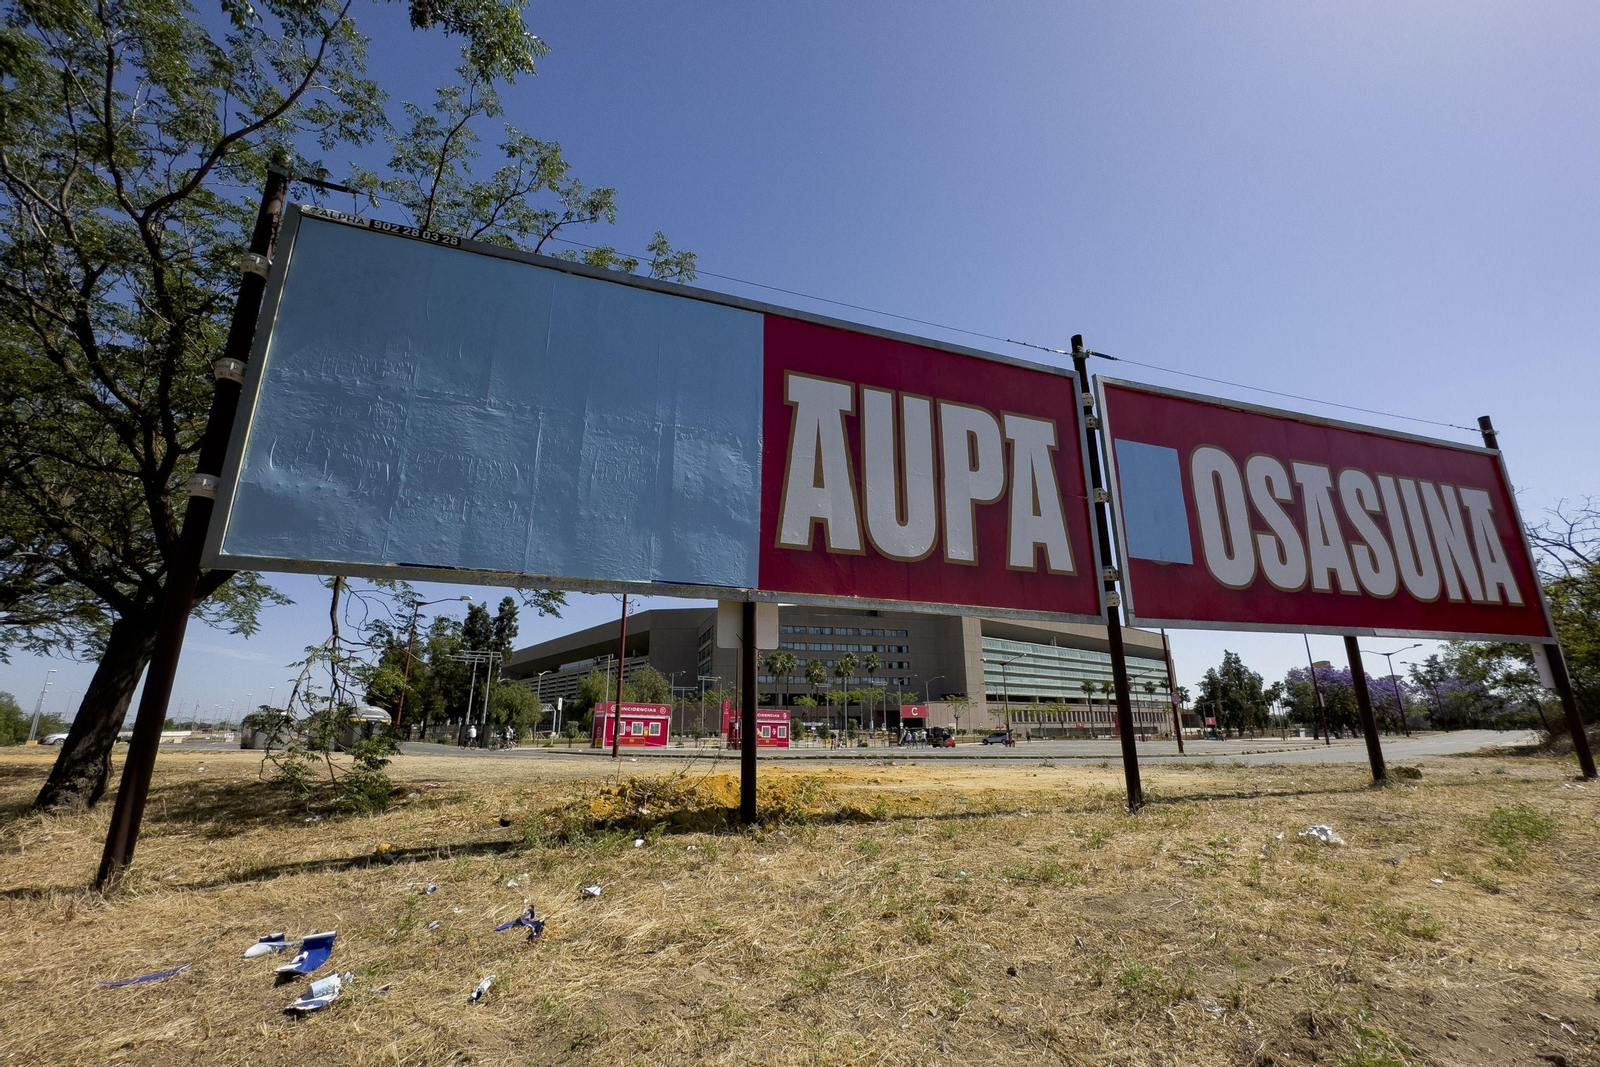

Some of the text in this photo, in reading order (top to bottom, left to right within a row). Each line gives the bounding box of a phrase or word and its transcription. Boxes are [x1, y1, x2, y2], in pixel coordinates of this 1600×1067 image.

[320, 209, 459, 247] ALPHA 902 28 03 28
[774, 369, 1078, 577] AUPA
[1189, 444, 1526, 608] OSASUNA
[911, 707, 919, 716] C
